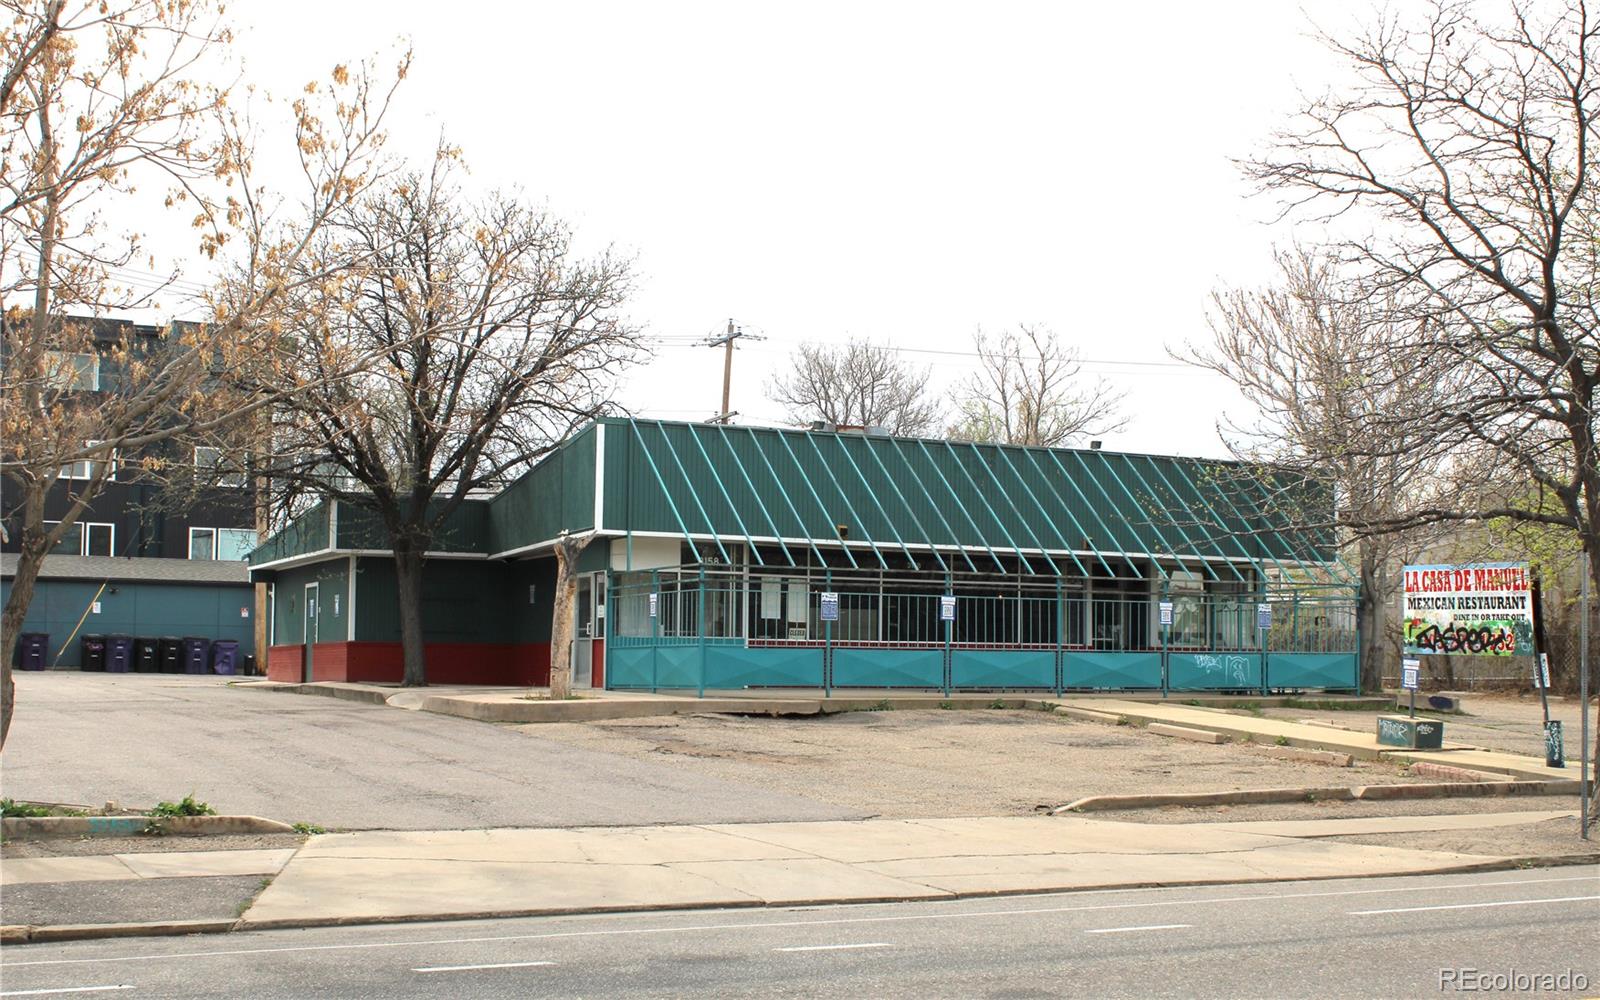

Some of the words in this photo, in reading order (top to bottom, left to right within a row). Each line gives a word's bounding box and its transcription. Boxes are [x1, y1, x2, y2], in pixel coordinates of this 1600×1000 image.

[1405, 571, 1420, 592] LA
[1422, 570, 1452, 592] CASA
[1454, 569, 1472, 592] DE
[1474, 567, 1529, 591] MANUEL
[1407, 596, 1455, 610] MEXICAN
[1457, 596, 1526, 610] RESTAURANT
[1453, 613, 1470, 621] DINE
[1472, 613, 1480, 621] IN
[1481, 613, 1491, 621] OR
[1492, 613, 1510, 621] TAKE
[1511, 613, 1526, 621] OUT
